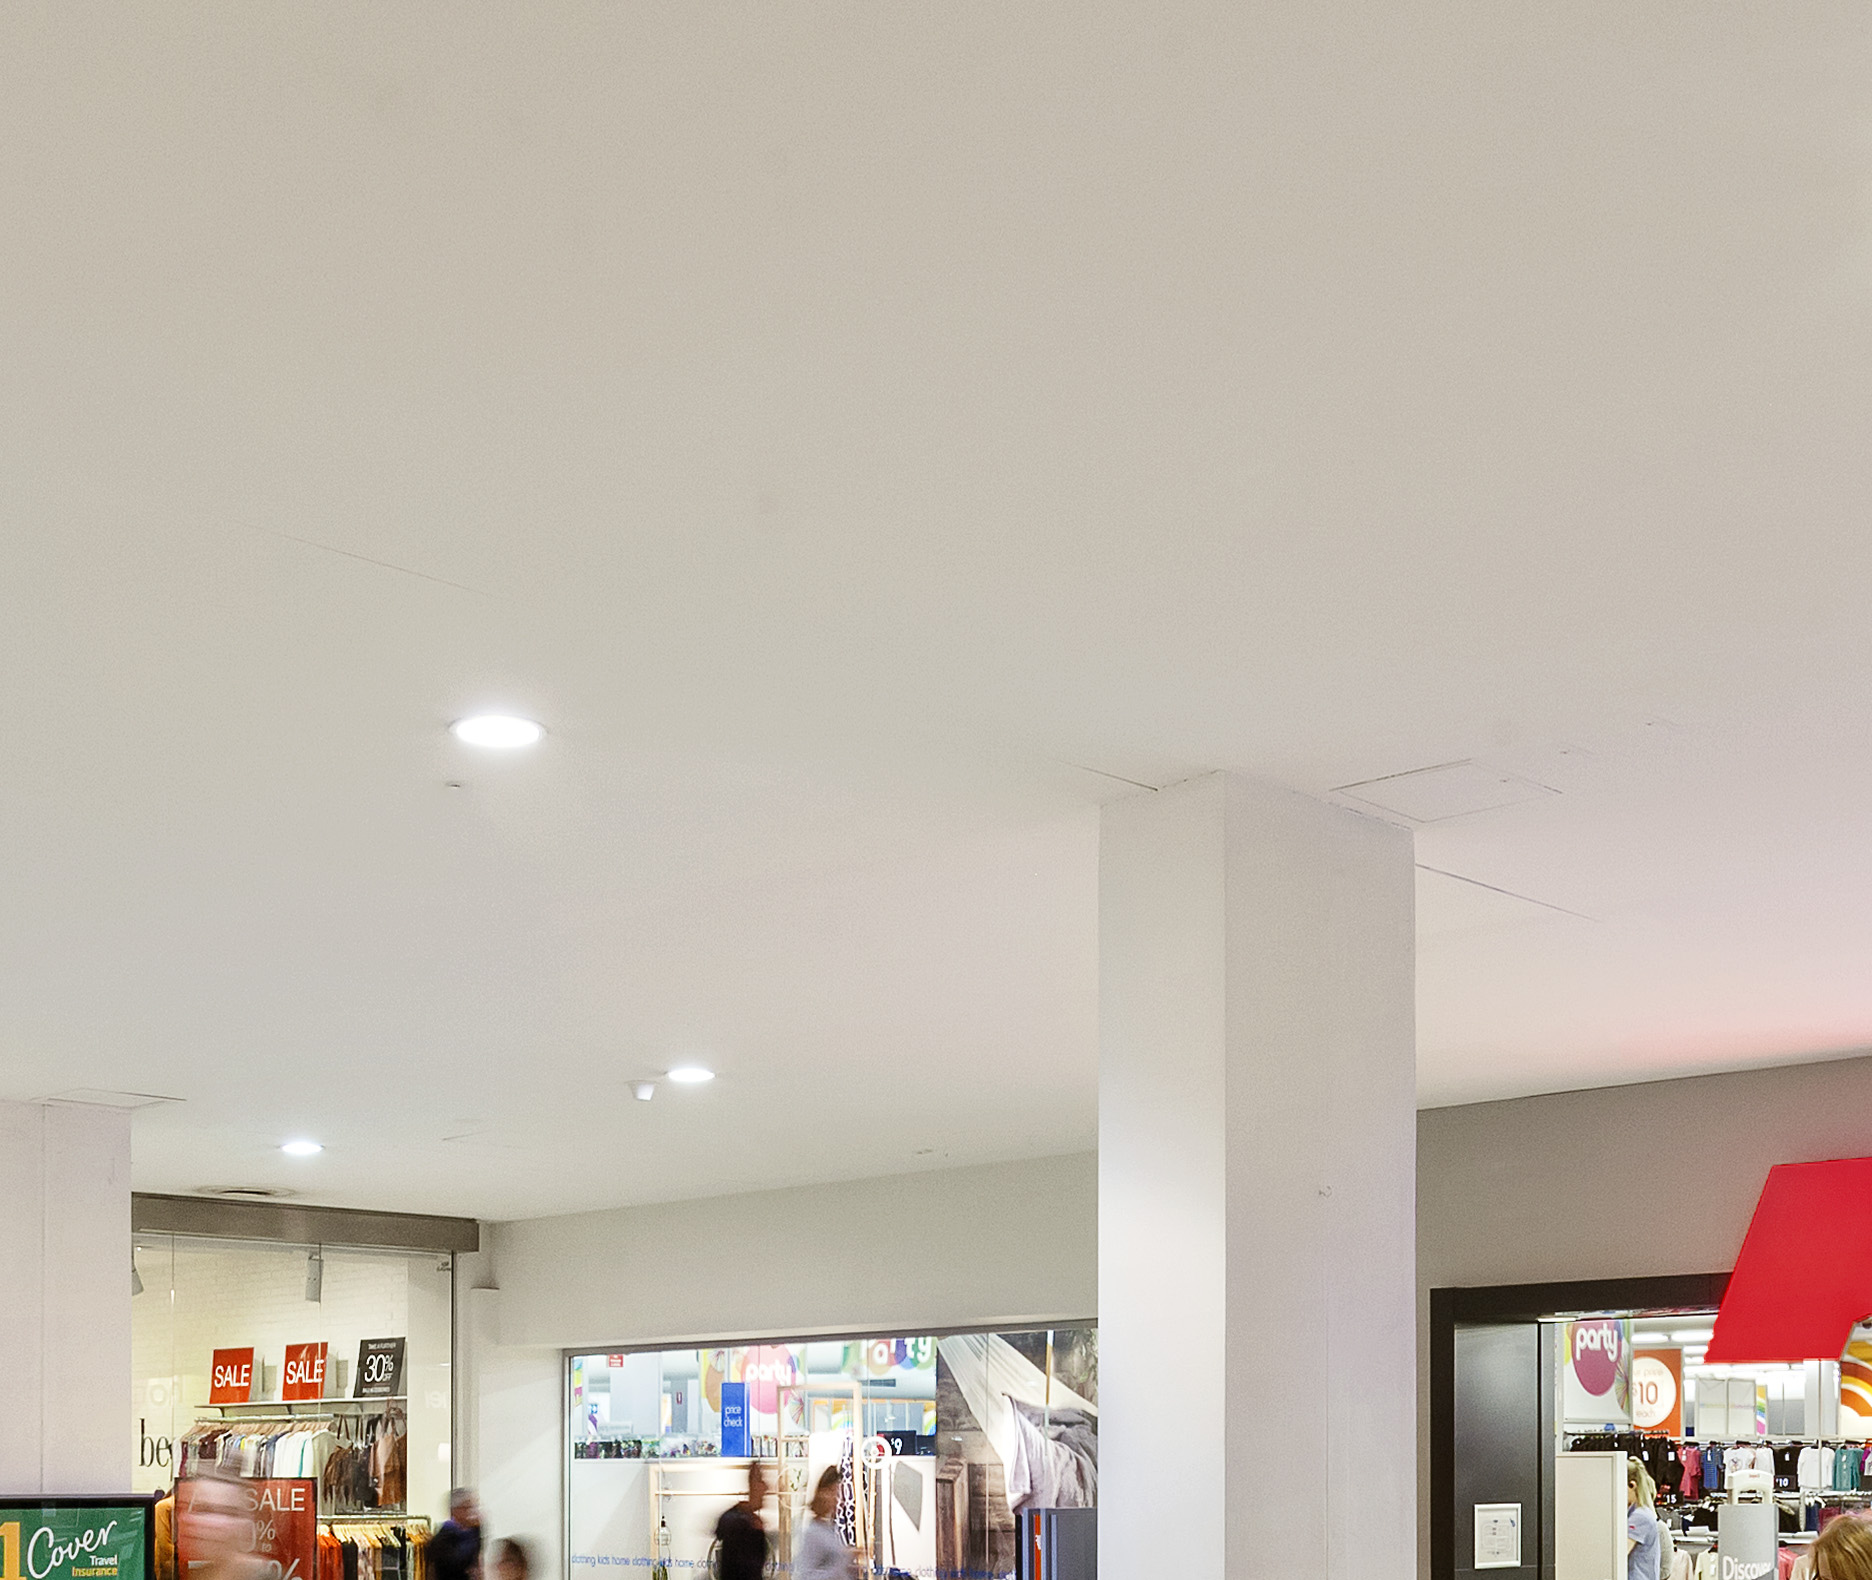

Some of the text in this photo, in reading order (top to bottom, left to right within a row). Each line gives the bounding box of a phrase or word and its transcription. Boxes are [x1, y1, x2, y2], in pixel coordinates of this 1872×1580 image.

[1576, 1322, 1618, 1362] party
[214, 1364, 251, 1388] SALE
[286, 1360, 324, 1385] SALE
[745, 1360, 792, 1386] party
[725, 1405, 742, 1416] price
[724, 1416, 743, 1428] check
[891, 1438, 903, 1455] $9
[90, 1555, 118, 1566] Travel
[612, 1556, 630, 1566] home
[1722, 1555, 1771, 1580] Discover
[72, 1566, 118, 1577] Insurance
